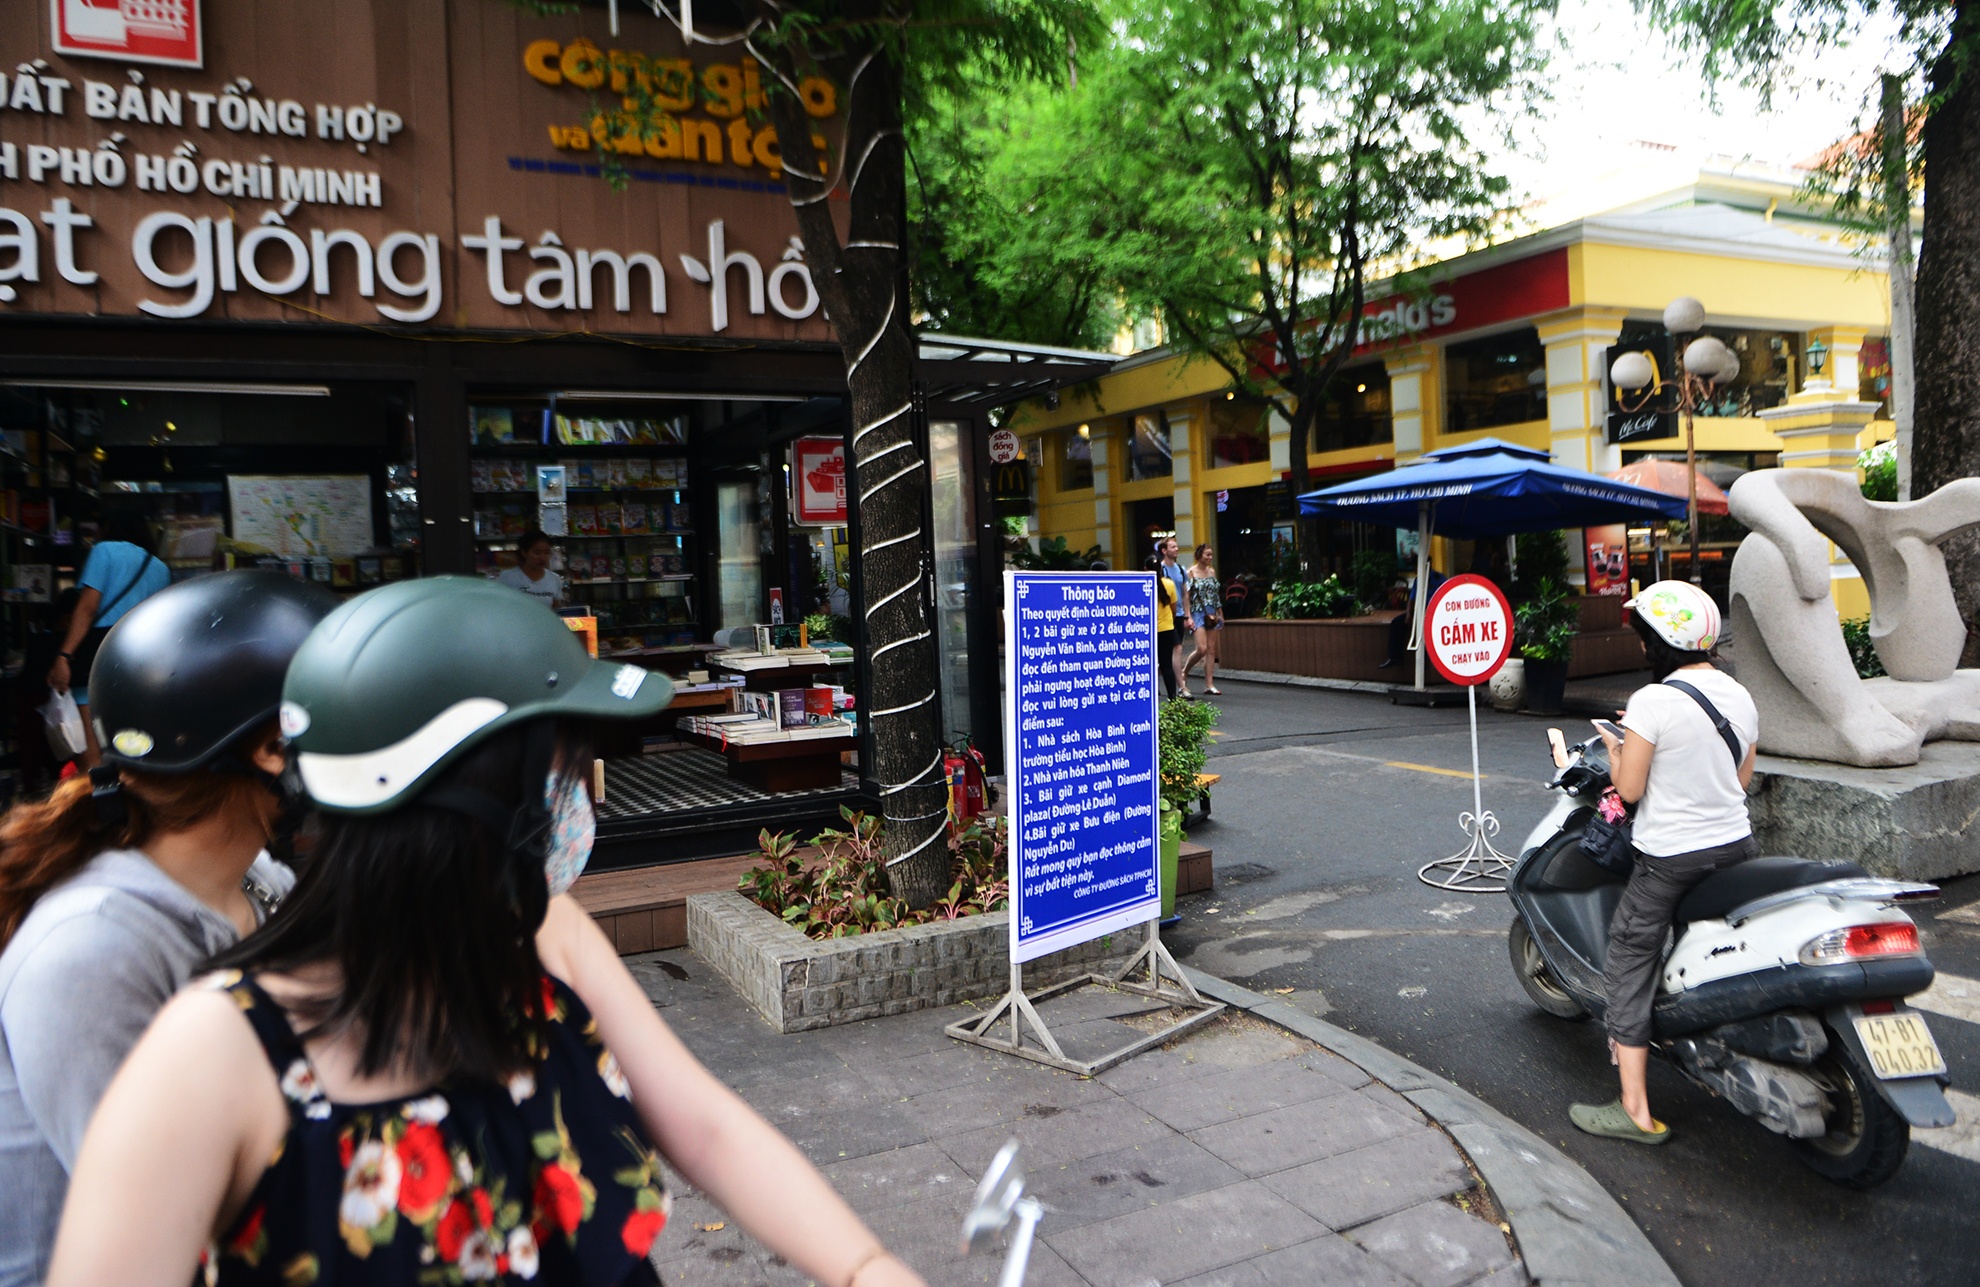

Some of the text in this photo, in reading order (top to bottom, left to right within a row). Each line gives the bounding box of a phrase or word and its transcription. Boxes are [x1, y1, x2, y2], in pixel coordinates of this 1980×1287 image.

[703, 55, 836, 117] gio
[0, 58, 403, 153] ẤT BẢN TỔNG HỢP
[727, 116, 828, 179] tộ
[27, 132, 127, 187] PHỐ
[135, 140, 199, 194] HỒ
[203, 155, 273, 200] CHÍ
[279, 167, 382, 207] MINH
[461, 216, 667, 315] tâm
[700, 219, 830, 333] hồ
[1062, 586, 1115, 604] Thông báo
[1446, 601, 1461, 612] CON
[1021, 605, 1149, 622] Theo quyết định của UBND Quận
[1022, 627, 1030, 640] 1,
[1034, 626, 1040, 638] 2
[1061, 624, 1075, 639] giữ
[1078, 627, 1087, 635] xe
[1100, 624, 1104, 634] 2
[1126, 622, 1149, 634] đường
[1440, 618, 1498, 646] CẤM XE
[1058, 643, 1074, 654] Văn
[1098, 640, 1118, 652] dành
[1120, 639, 1134, 650] cho
[1136, 638, 1149, 651] bạn
[1474, 650, 1490, 661] VÀO
[1022, 654, 1149, 678] đọc đến tham quan Đường Sách
[1022, 680, 1042, 697] phải
[1044, 680, 1072, 694] ngưng
[1074, 677, 1092, 690] hoạt
[1094, 675, 1117, 688] động.
[1136, 672, 1150, 684] bạn
[1022, 700, 1038, 714] đọc
[1042, 697, 1056, 710] vui
[1060, 696, 1078, 709] lòng
[1098, 694, 1107, 703] xe
[1110, 690, 1120, 704] tại
[1124, 689, 1136, 700] các
[1138, 688, 1150, 701] địa
[1024, 738, 1031, 749] 1.
[1038, 734, 1055, 747] Nhà
[1062, 730, 1080, 744] sách
[1086, 728, 1102, 740] Hòa
[1130, 720, 1150, 735] (cạnh
[1046, 718, 1064, 728] sau:
[1023, 754, 1053, 768] trường
[1073, 748, 1088, 762] học
[1089, 744, 1104, 757] Hòa
[1024, 758, 1129, 786] 2. Nhà văn hóa Thanh Niên
[1024, 793, 1032, 805] 3.
[1059, 785, 1073, 801] giữ
[1078, 784, 1088, 794] xe
[1094, 776, 1112, 793] cạnh
[1118, 769, 1150, 786] Diamond
[1051, 822, 1066, 838] giữ
[1070, 822, 1079, 831] xe
[1104, 810, 1120, 824] điện
[1124, 805, 1151, 820] (Đường
[1052, 803, 1080, 817] Đường
[1060, 838, 1075, 851] Du)
[1041, 860, 1065, 874] mong
[1083, 852, 1098, 864] bạn
[1100, 847, 1113, 860] đọc
[1034, 882, 1045, 896] sự
[1061, 874, 1076, 888] tiện
[1074, 886, 1090, 898] CÔNG
[1091, 884, 1098, 893] TY
